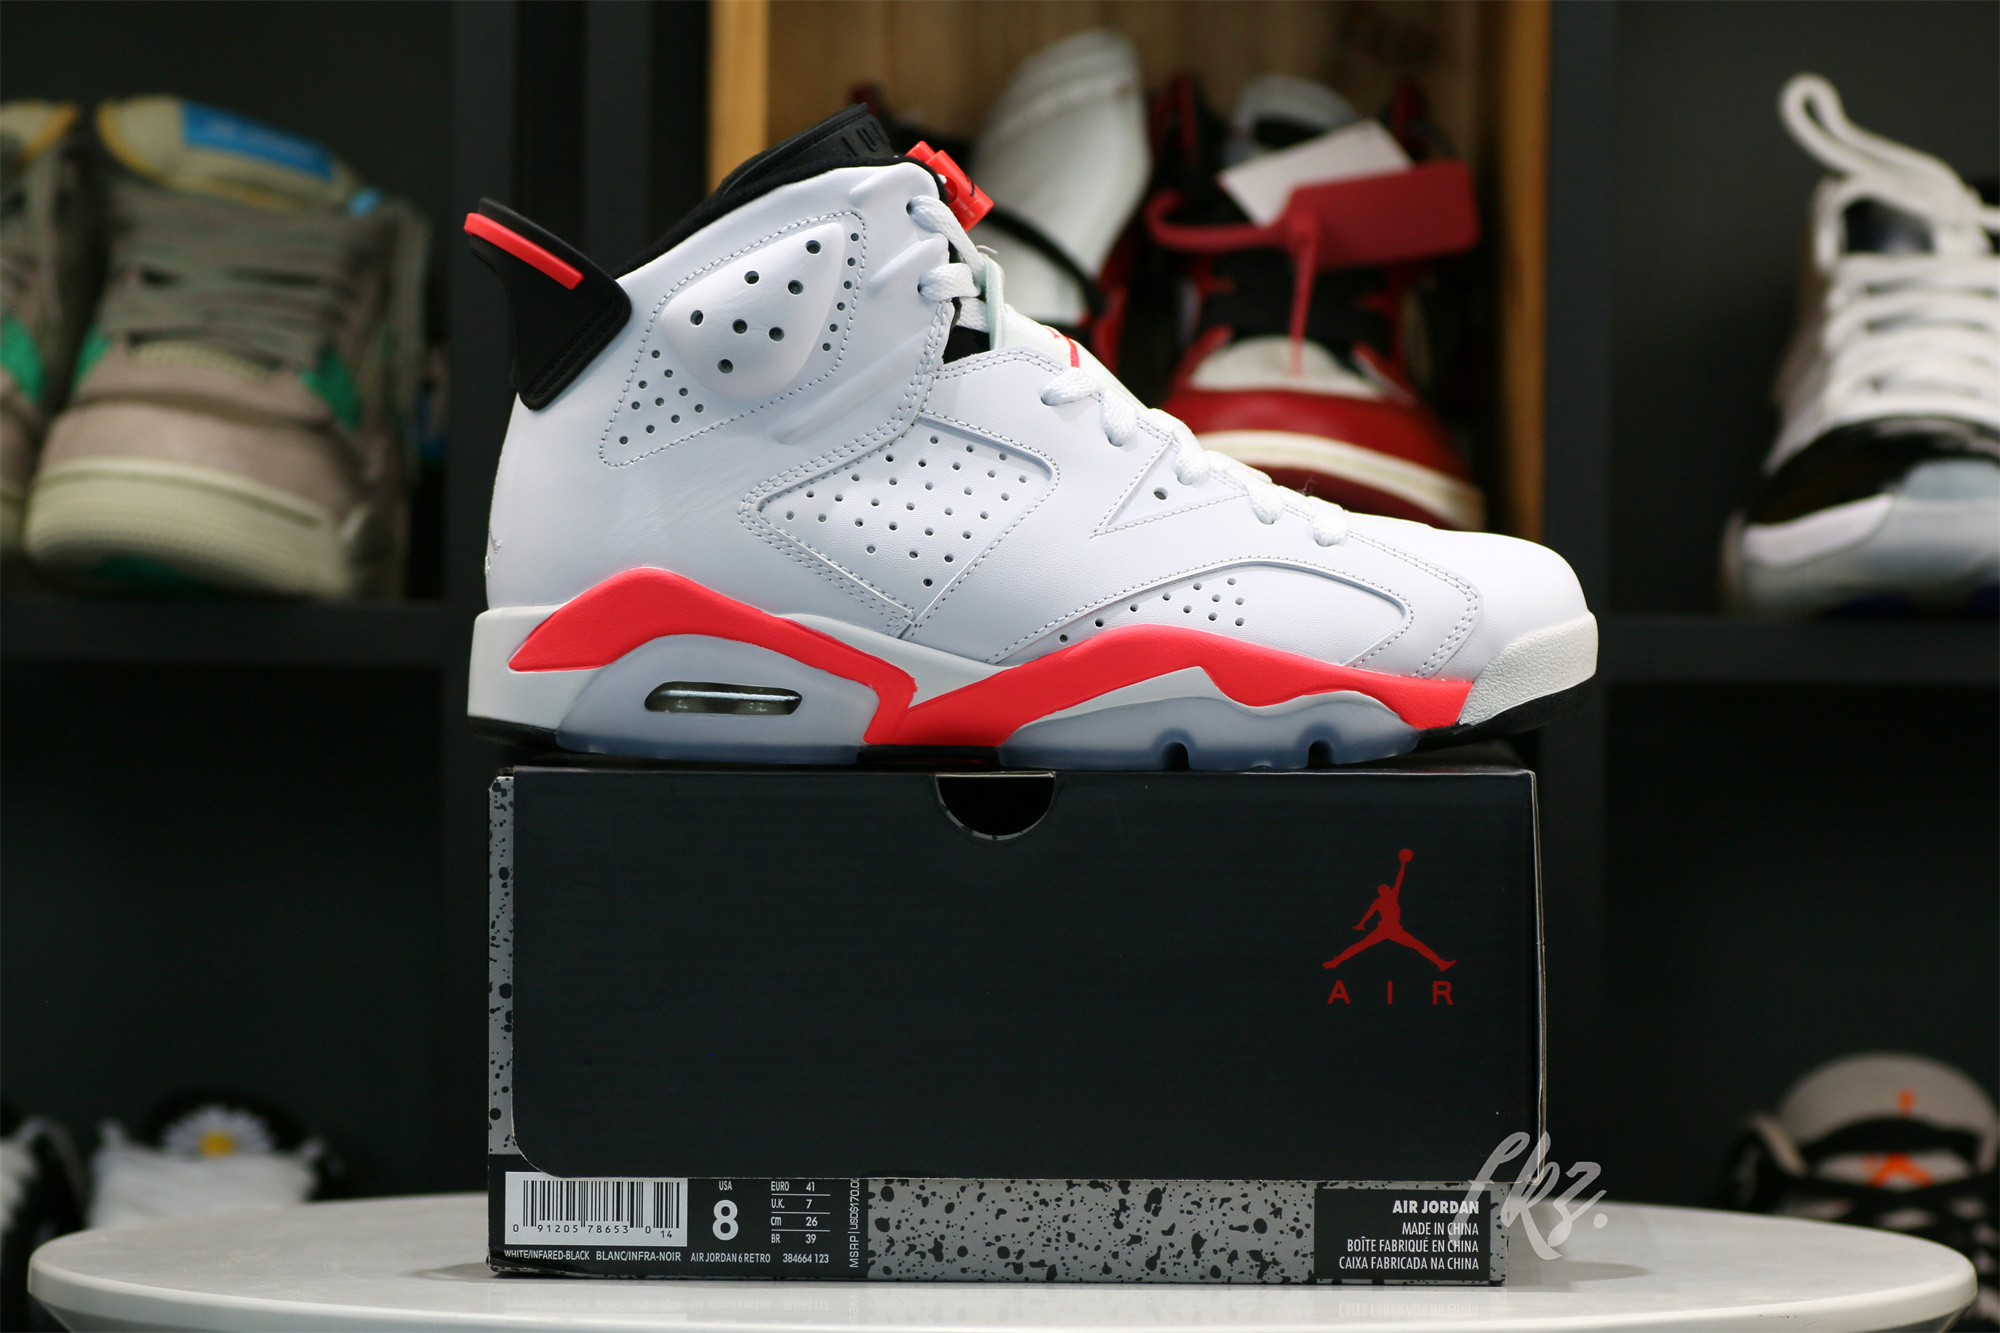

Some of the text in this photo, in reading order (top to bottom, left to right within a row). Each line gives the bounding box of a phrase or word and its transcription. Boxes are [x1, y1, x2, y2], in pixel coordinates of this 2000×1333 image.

[1327, 979, 1454, 1006] AIR
[718, 1180, 733, 1191] USA
[770, 1180, 816, 1192] EURO 41
[770, 1198, 813, 1209] U.K. 7
[1392, 1200, 1479, 1214] AIR JORDAN
[712, 1199, 739, 1241] 8
[770, 1216, 818, 1227] cm 26
[512, 1224, 651, 1234] 0 91205 78653 0
[660, 1230, 673, 1239] 14
[1402, 1222, 1479, 1235] MADE IN CHINA
[771, 1233, 817, 1244] BR 39
[1347, 1236, 1479, 1252] BOÎTE FABRIQUÉ EN CHINA
[504, 1249, 682, 1262] WHITE/INFARED-BLACK BLANC/INFRA-NOIR
[690, 1252, 771, 1263] AIR JORDAN 6 RETRO
[849, 1235, 860, 1268] MSRP
[782, 1253, 829, 1263] 384664 123
[1339, 1256, 1479, 1269] CAIXA FABRICADA NA CHINA
